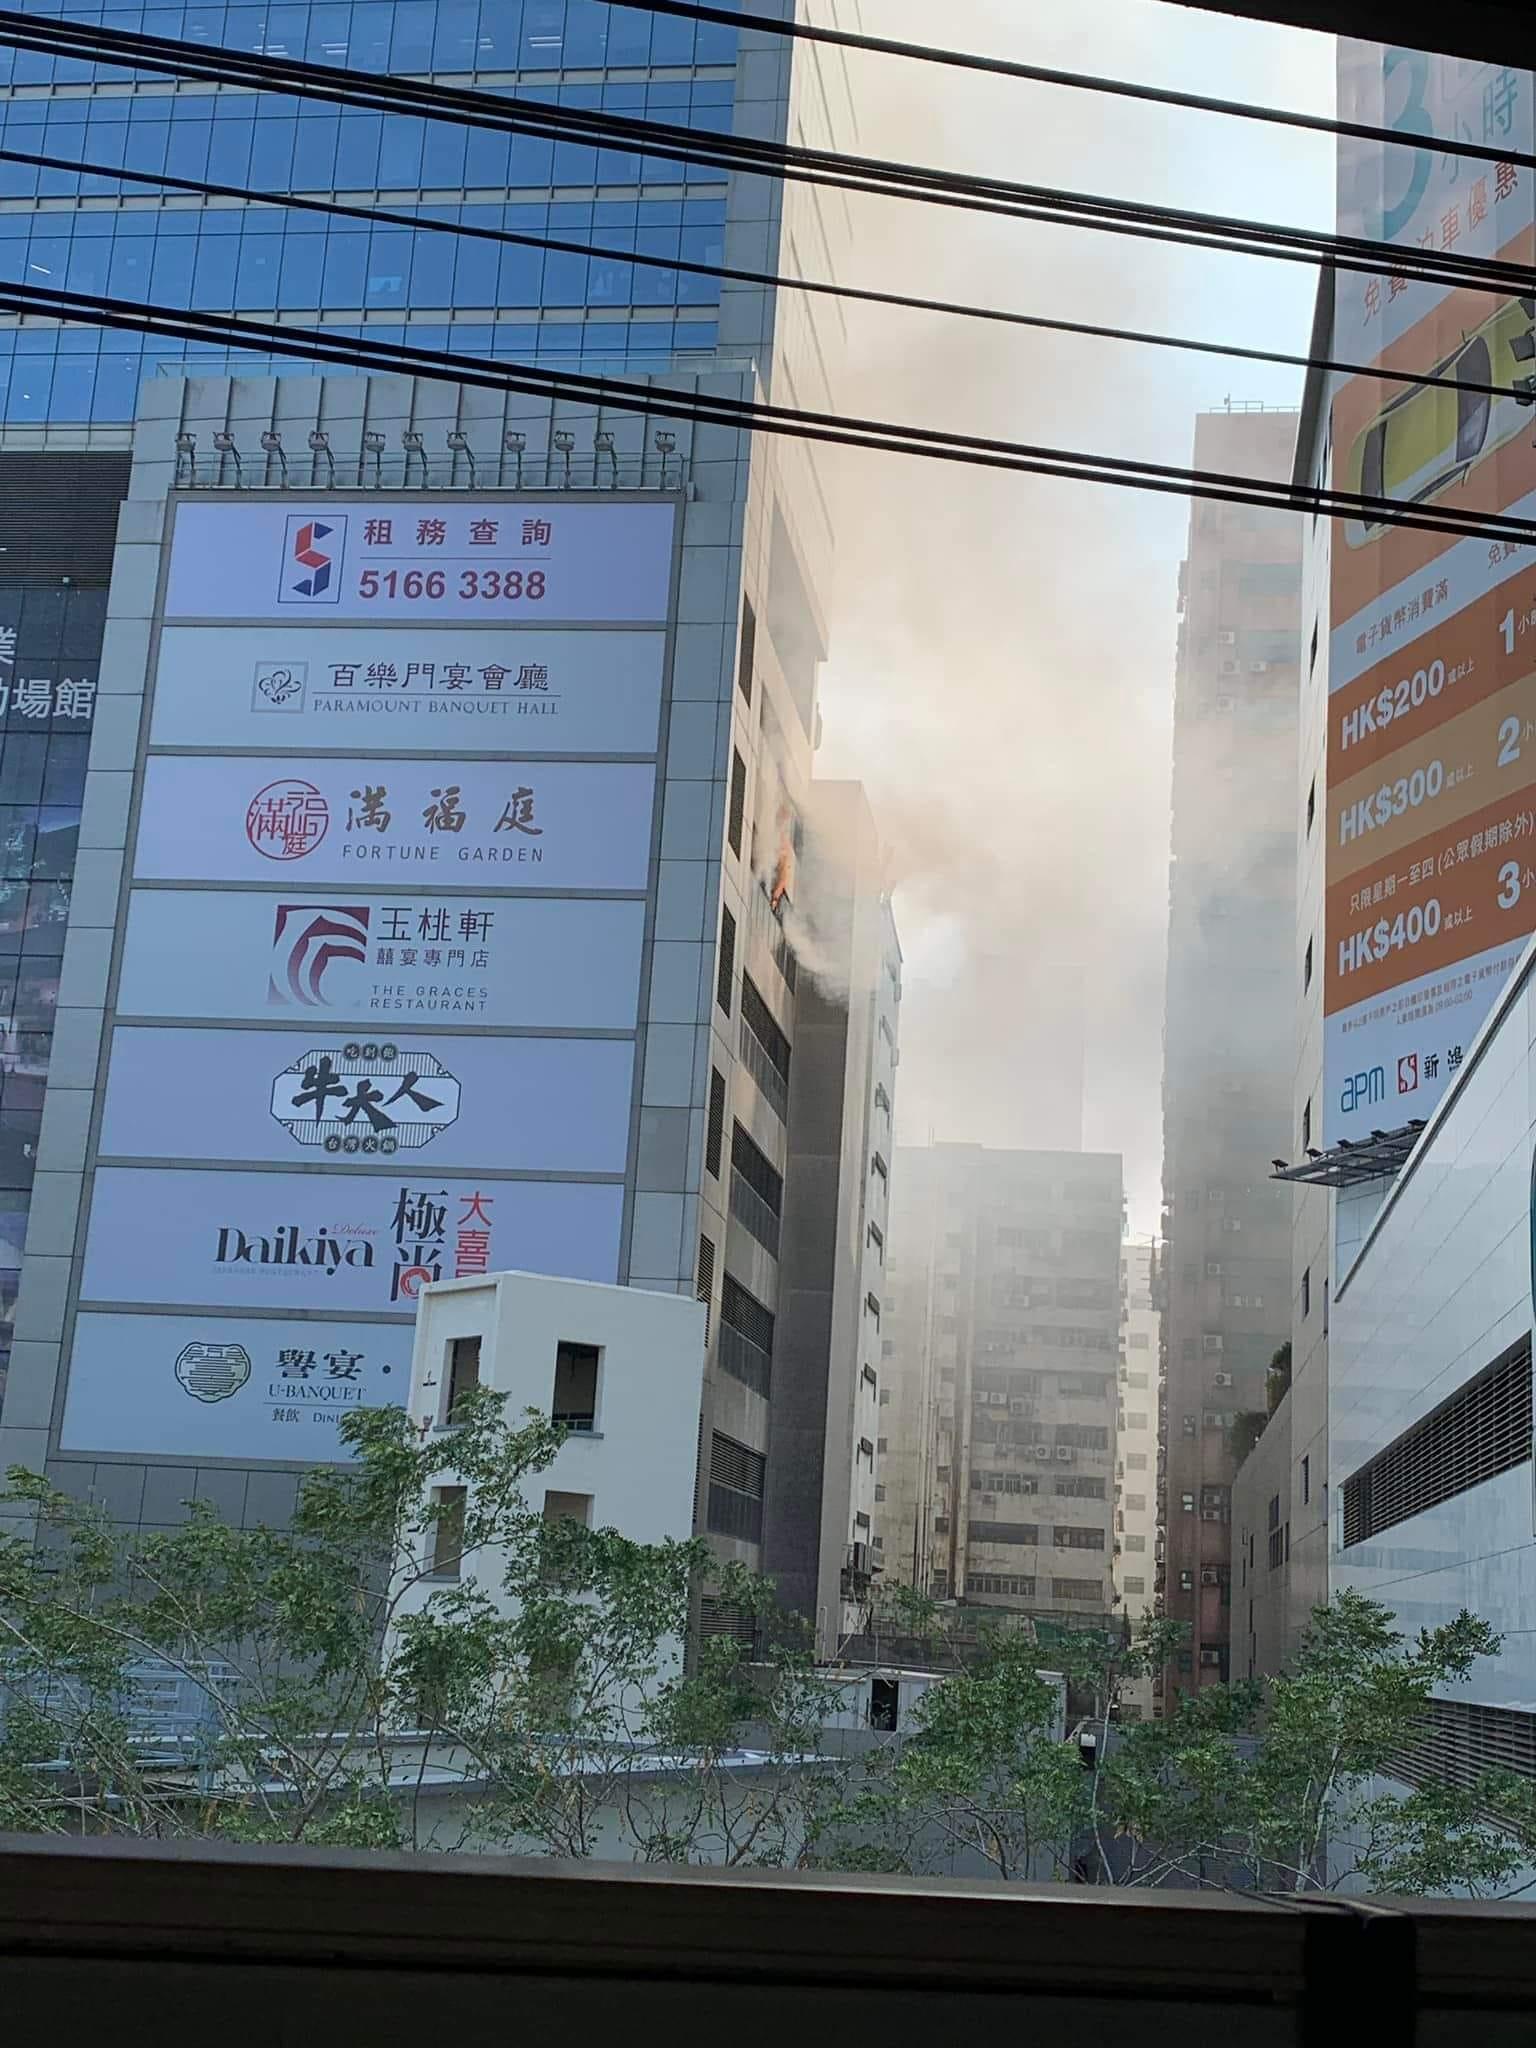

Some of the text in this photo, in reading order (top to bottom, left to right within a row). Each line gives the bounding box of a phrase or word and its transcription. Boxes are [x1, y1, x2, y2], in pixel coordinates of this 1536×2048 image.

[363, 518, 552, 546] 租務查詢
[359, 570, 546, 600] 5166 3388
[1499, 607, 1515, 655] 1
[327, 662, 550, 691] 百樂門宴會廳
[0, 676, 97, 719] 場館
[313, 699, 560, 715] PARAMOUNT BANQUET HALL
[1342, 659, 1445, 750] HK$200
[1497, 716, 1521, 767] 2
[1340, 759, 1443, 846] HK$300
[343, 844, 544, 863] FORTUNE GARDEN
[1497, 861, 1521, 909] 3
[1339, 898, 1441, 976] HK$400
[376, 948, 489, 968] 囍宴專門店
[370, 998, 488, 1012] RESTAURANT
[372, 984, 488, 999] THE GRACES
[291, 1056, 446, 1133] 牛大人
[215, 1225, 377, 1276] Daikiya
[268, 1384, 367, 1400] U-BANQUET
